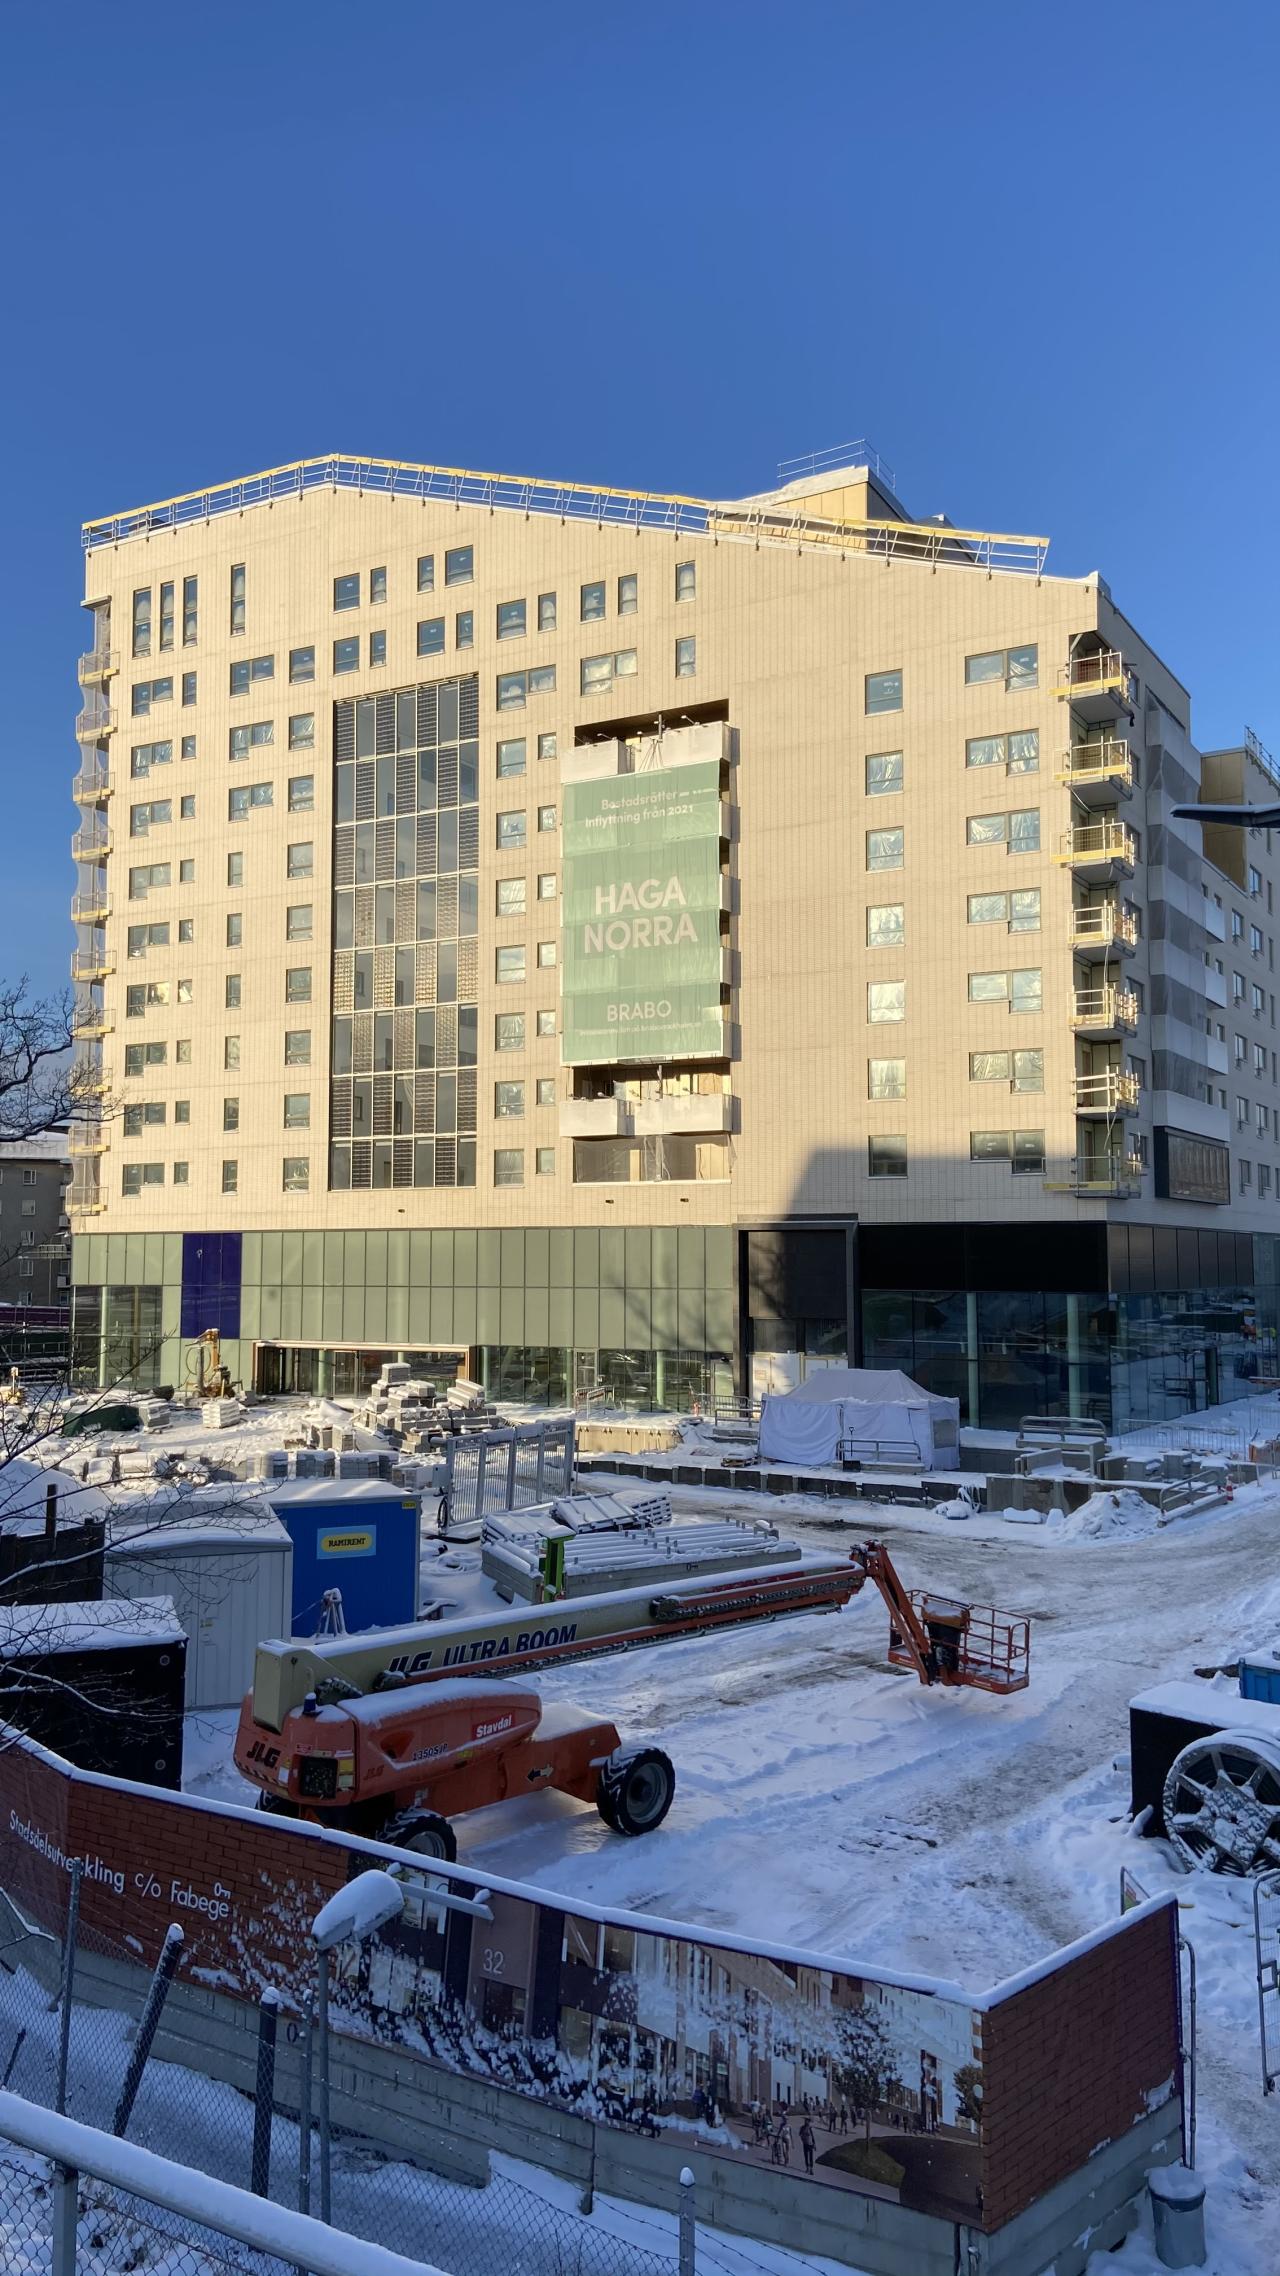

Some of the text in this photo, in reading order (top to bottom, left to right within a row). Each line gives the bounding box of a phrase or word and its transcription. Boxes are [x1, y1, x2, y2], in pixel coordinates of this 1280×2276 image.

[601, 791, 677, 810] Bostadsrätter
[585, 804, 693, 829] Inflyttning från 2021
[595, 876, 687, 915] HAGA
[584, 913, 698, 954] NORRA
[607, 999, 672, 1022] BRABO
[328, 1537, 366, 1547] RAMIRENT
[443, 1637, 510, 1667] ULTRA
[516, 1624, 577, 1652] BOOM
[476, 1714, 512, 1738] Stavdal
[246, 1740, 281, 1769] JLG
[9, 1809, 229, 1920] Stadsdelsutvekling c/o Fabege
[483, 1949, 503, 1974] 32
